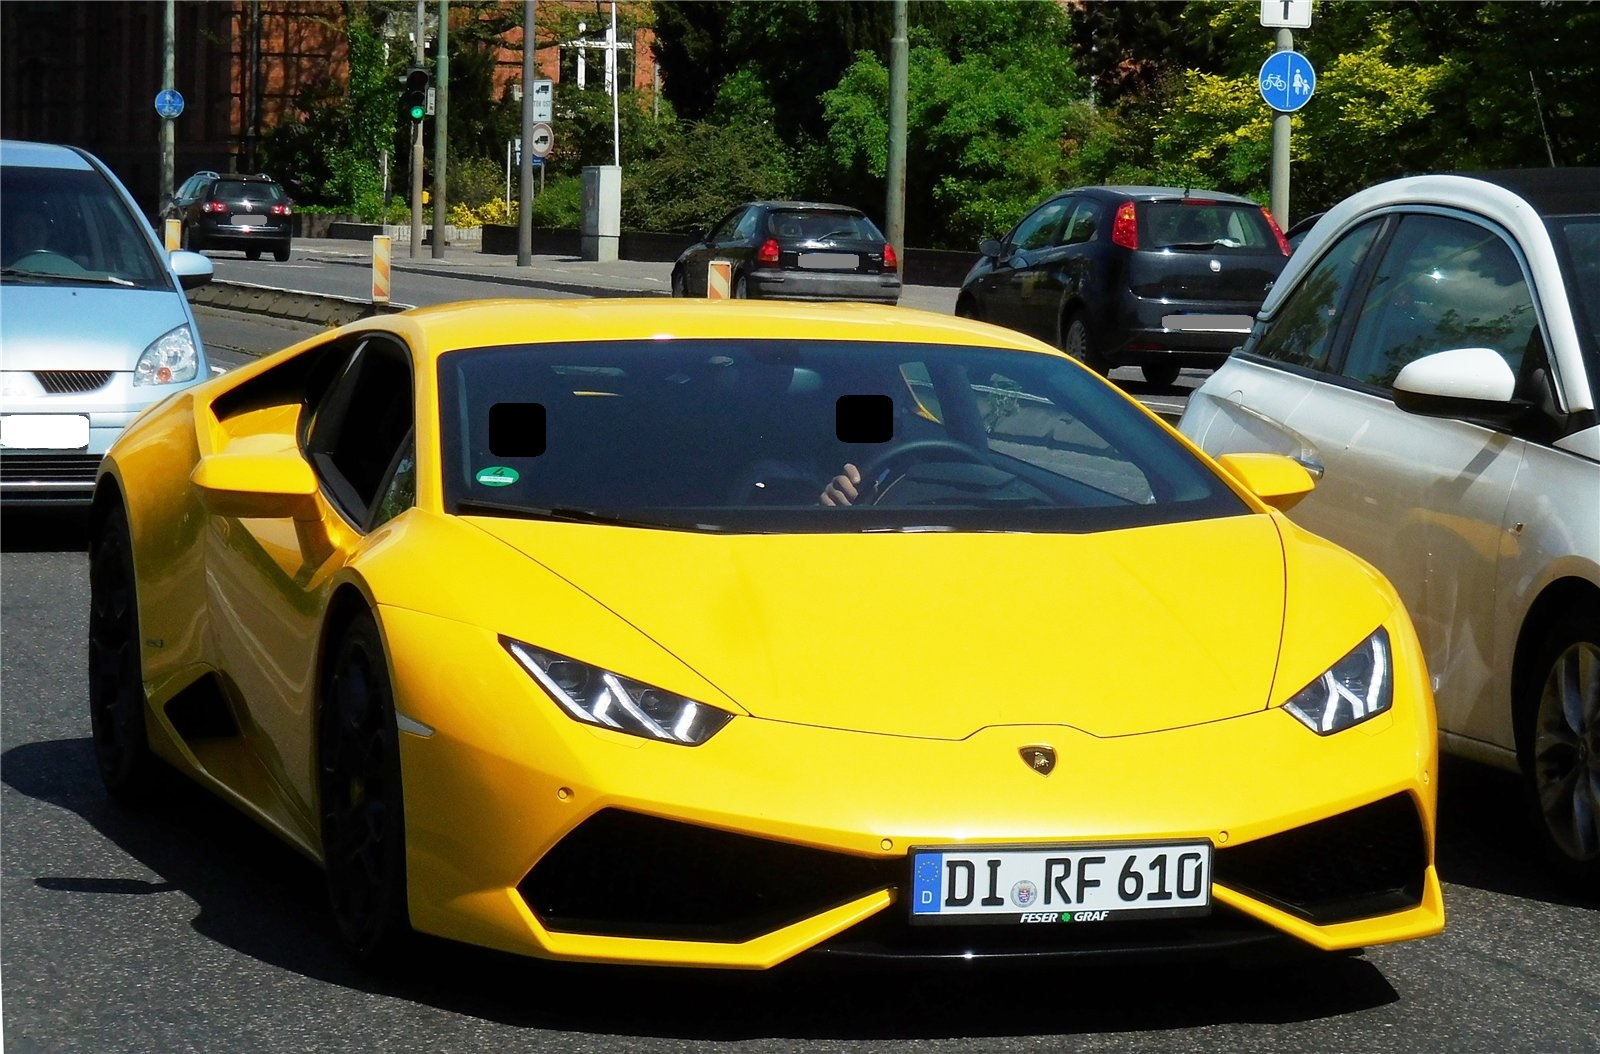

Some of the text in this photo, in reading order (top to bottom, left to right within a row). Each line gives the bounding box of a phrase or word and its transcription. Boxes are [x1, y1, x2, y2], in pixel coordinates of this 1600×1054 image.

[492, 467, 504, 477] 4
[945, 853, 1202, 907] DI RF 610
[922, 891, 933, 904] D
[1020, 911, 1109, 923] FESER GRAF
